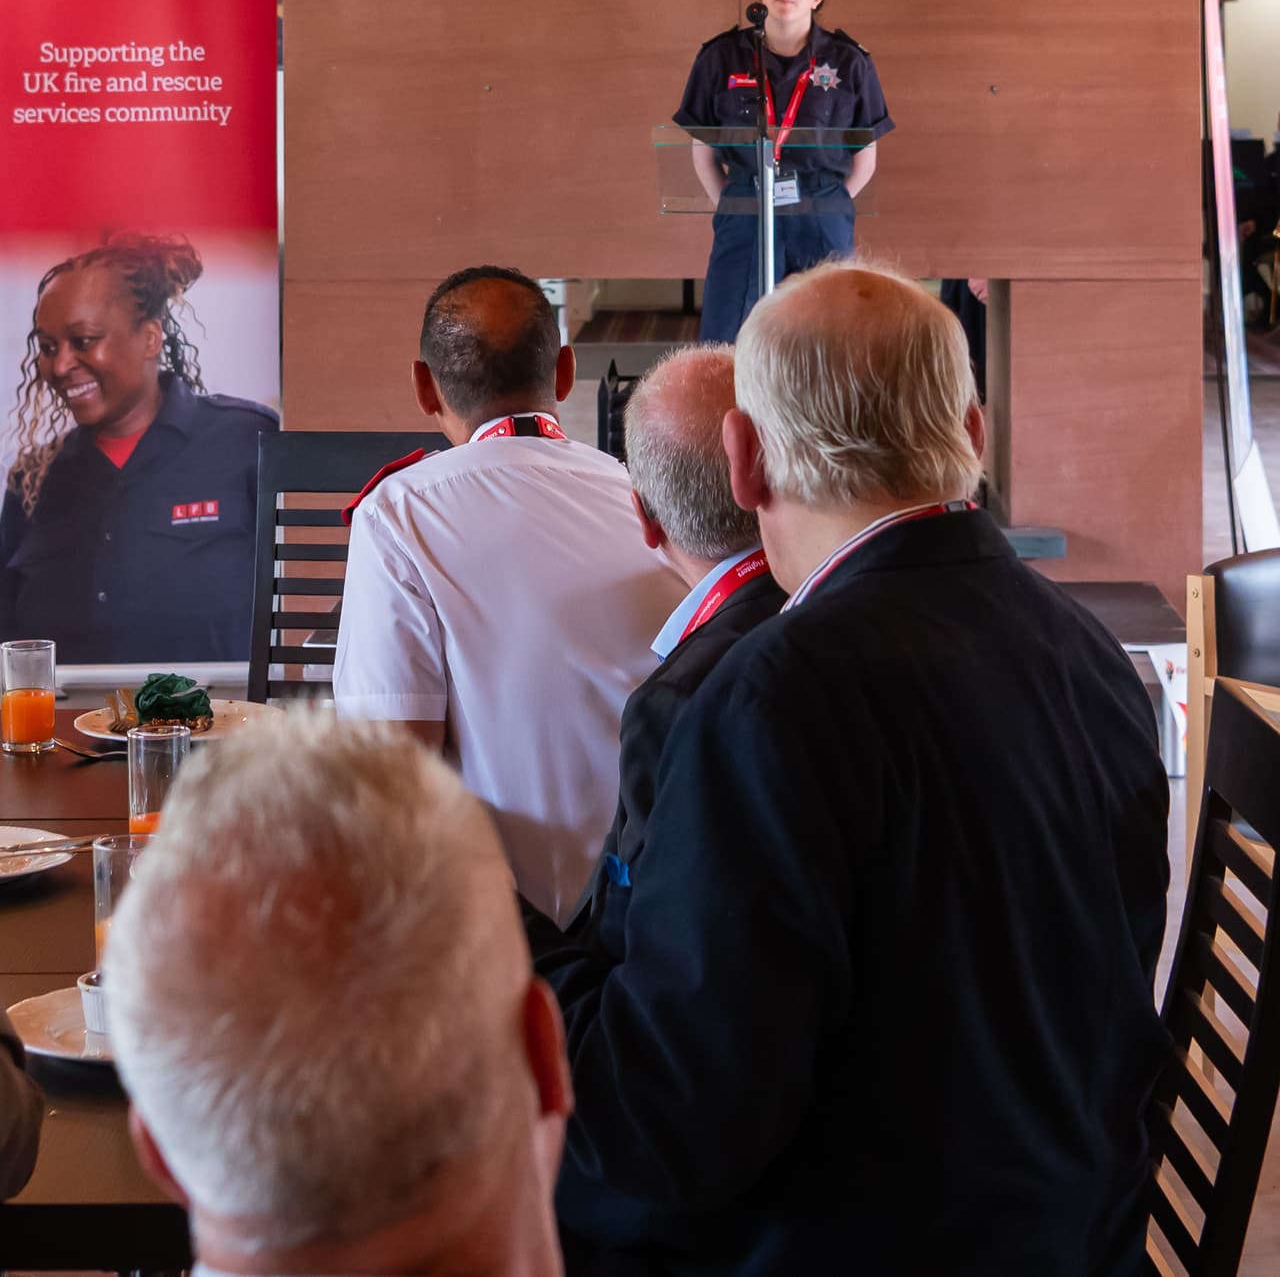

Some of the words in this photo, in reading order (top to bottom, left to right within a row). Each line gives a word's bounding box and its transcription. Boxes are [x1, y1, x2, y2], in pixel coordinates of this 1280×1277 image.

[39, 41, 165, 68] Supporting
[170, 41, 206, 62] the
[23, 72, 59, 94] UK
[64, 72, 101, 93] fire
[106, 71, 148, 93] and
[152, 76, 223, 92] rescue
[13, 102, 101, 124] services
[105, 101, 232, 126] community
